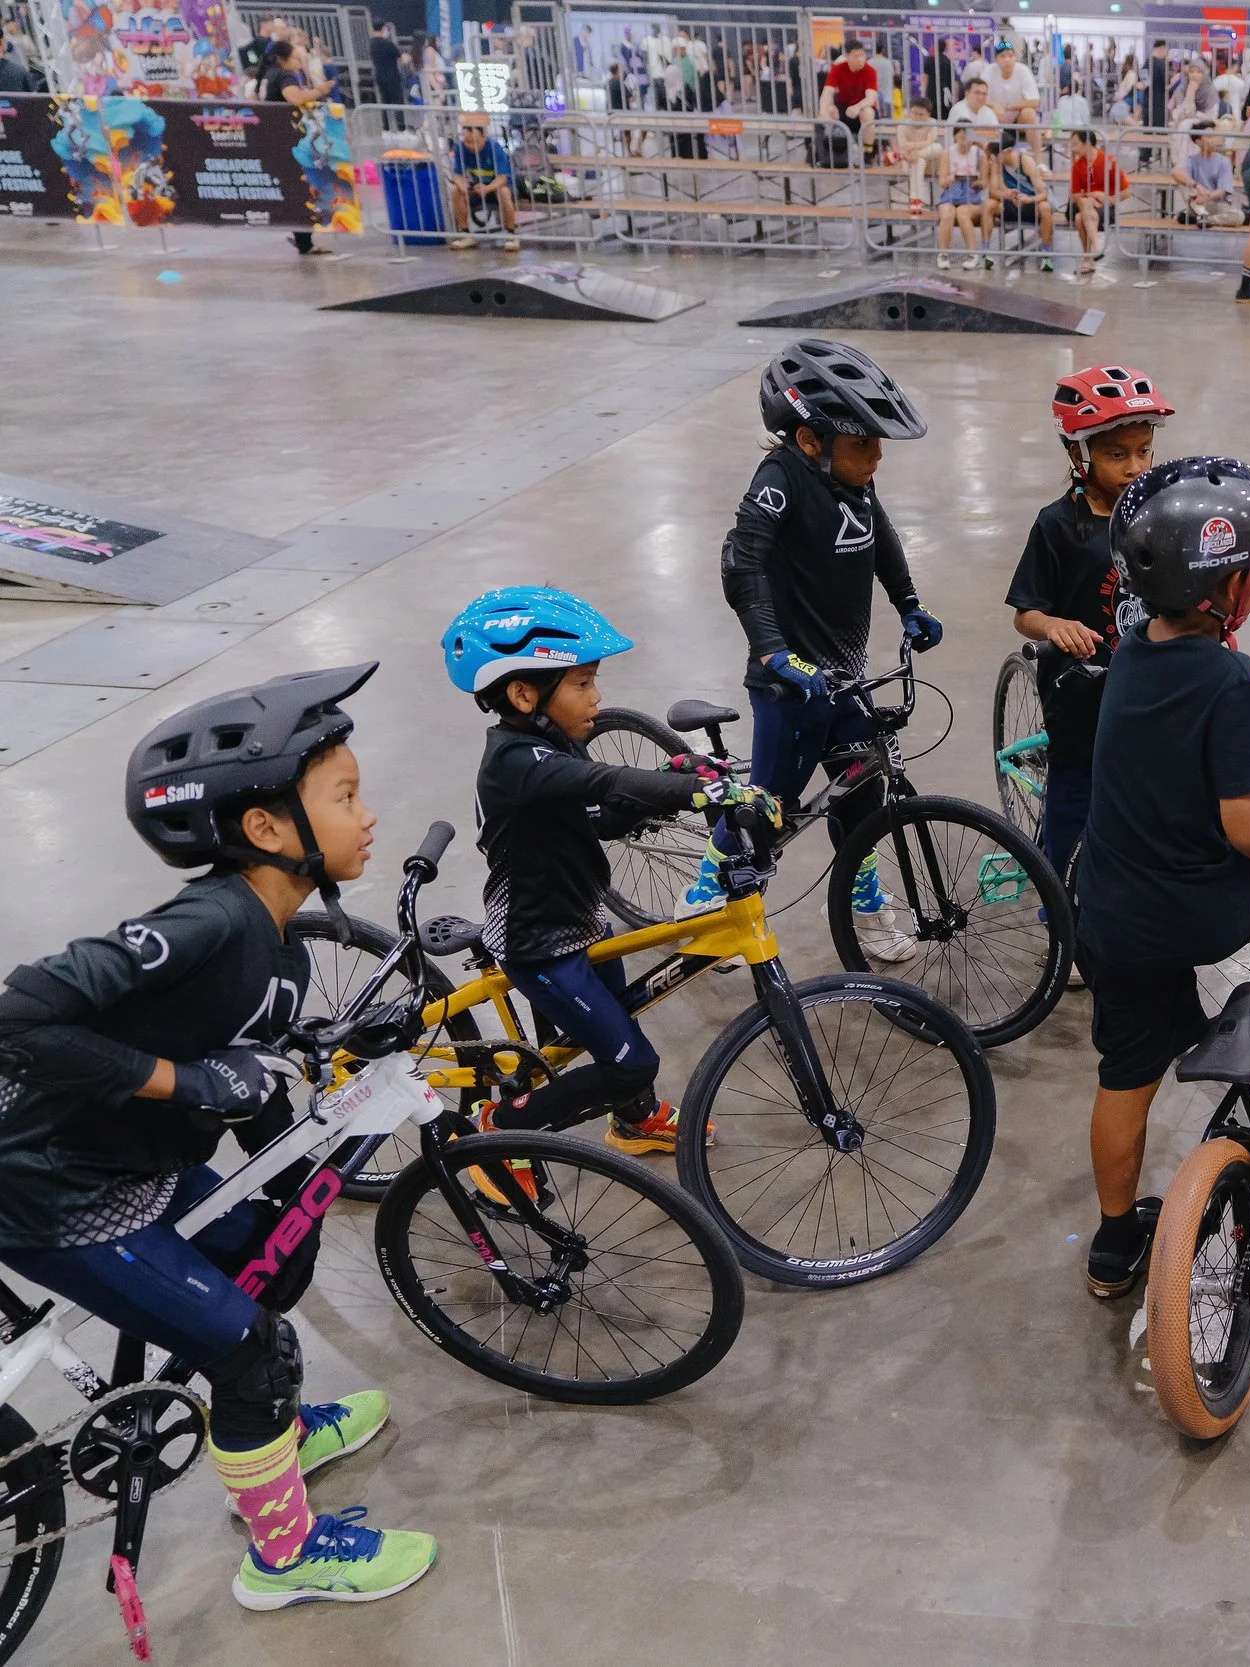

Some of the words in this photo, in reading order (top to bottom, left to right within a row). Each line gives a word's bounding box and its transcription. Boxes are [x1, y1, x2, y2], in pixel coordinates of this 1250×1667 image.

[204, 158, 263, 173] SINGAPORE
[195, 171, 232, 185] URBAN
[231, 172, 273, 187] SPORTS
[197, 185, 239, 200] FITNESS
[239, 186, 285, 201] FESTIVAL
[792, 400, 811, 420] Dina
[835, 546, 858, 554] AIRDROZ
[1188, 551, 1249, 570] PRO-TEC
[483, 616, 535, 630] PMT
[549, 649, 578, 663] Siddiq
[166, 782, 205, 803] Sally
[573, 996, 592, 1013] KIPRUN
[801, 995, 901, 1010] FORWARD
[234, 1167, 343, 1300] EYBO
[786, 1247, 889, 1268] FORWARD
